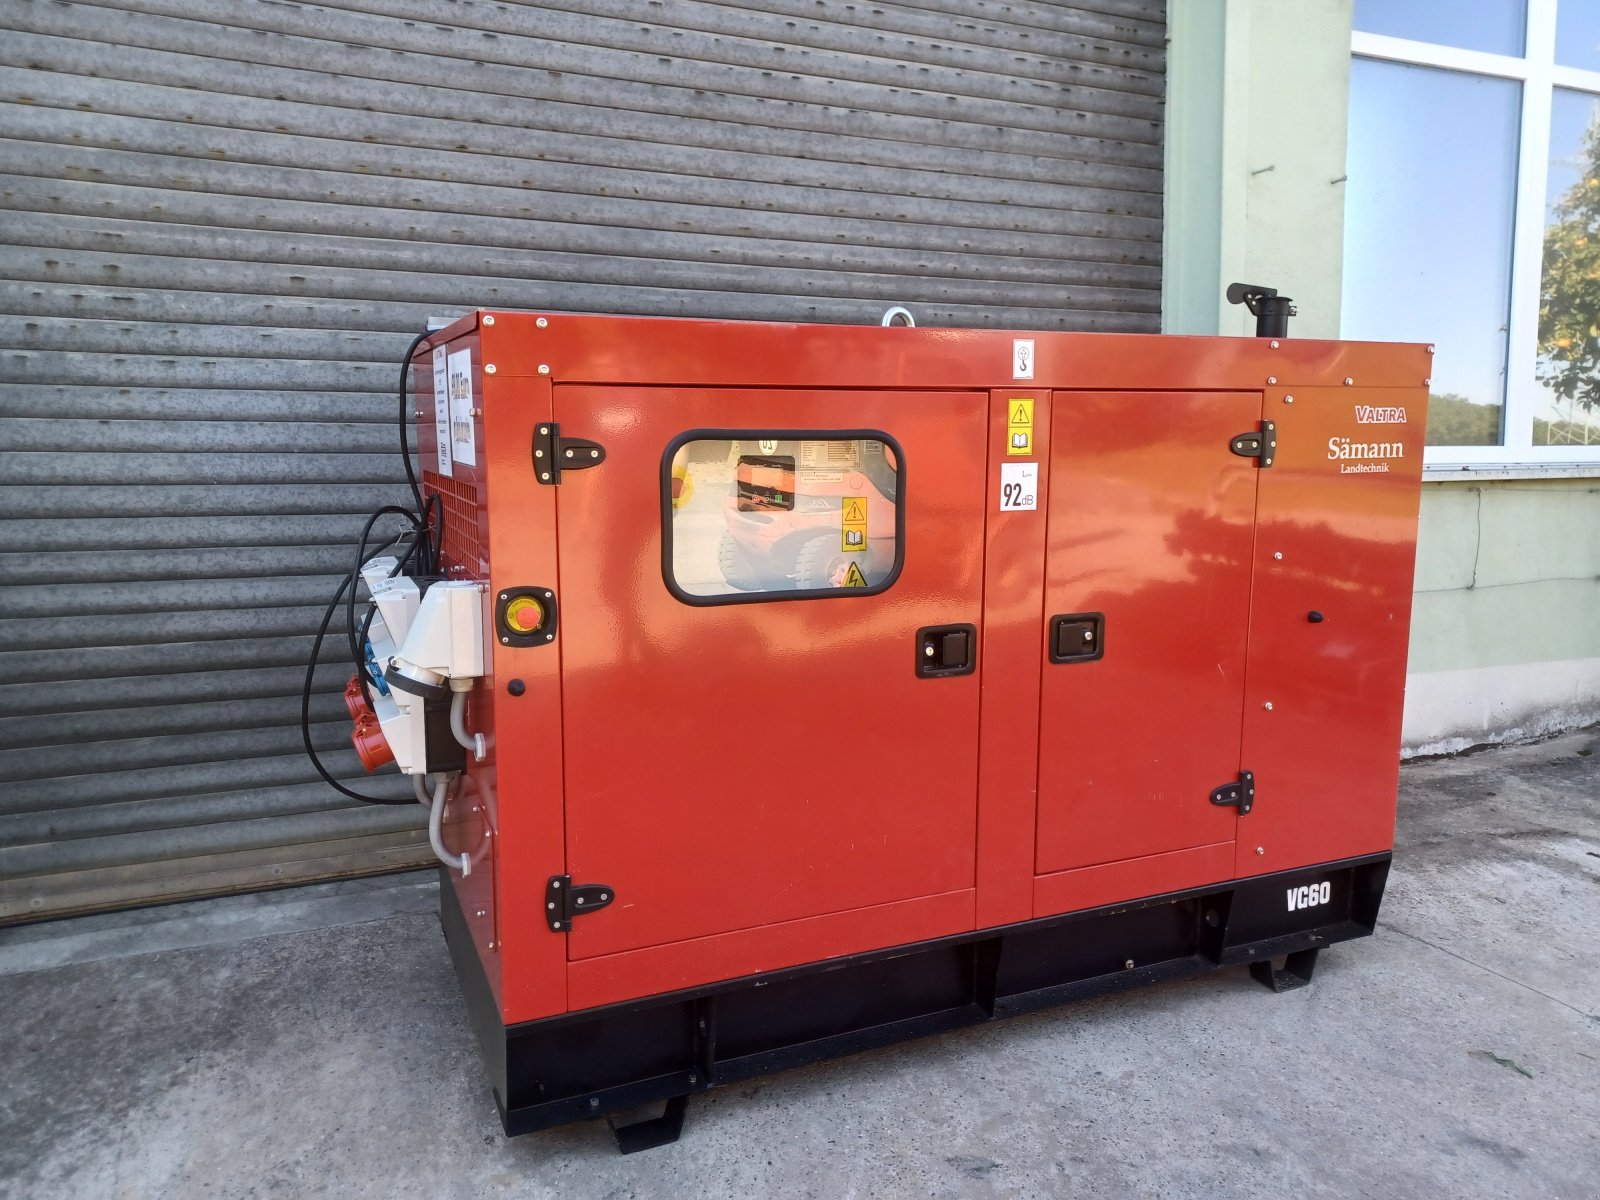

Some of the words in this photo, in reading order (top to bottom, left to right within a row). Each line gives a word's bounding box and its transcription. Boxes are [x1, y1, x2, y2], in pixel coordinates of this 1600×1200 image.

[1355, 405, 1407, 423] VALTRA
[1327, 436, 1404, 460] Sämann
[1341, 463, 1389, 473] Landtechnik
